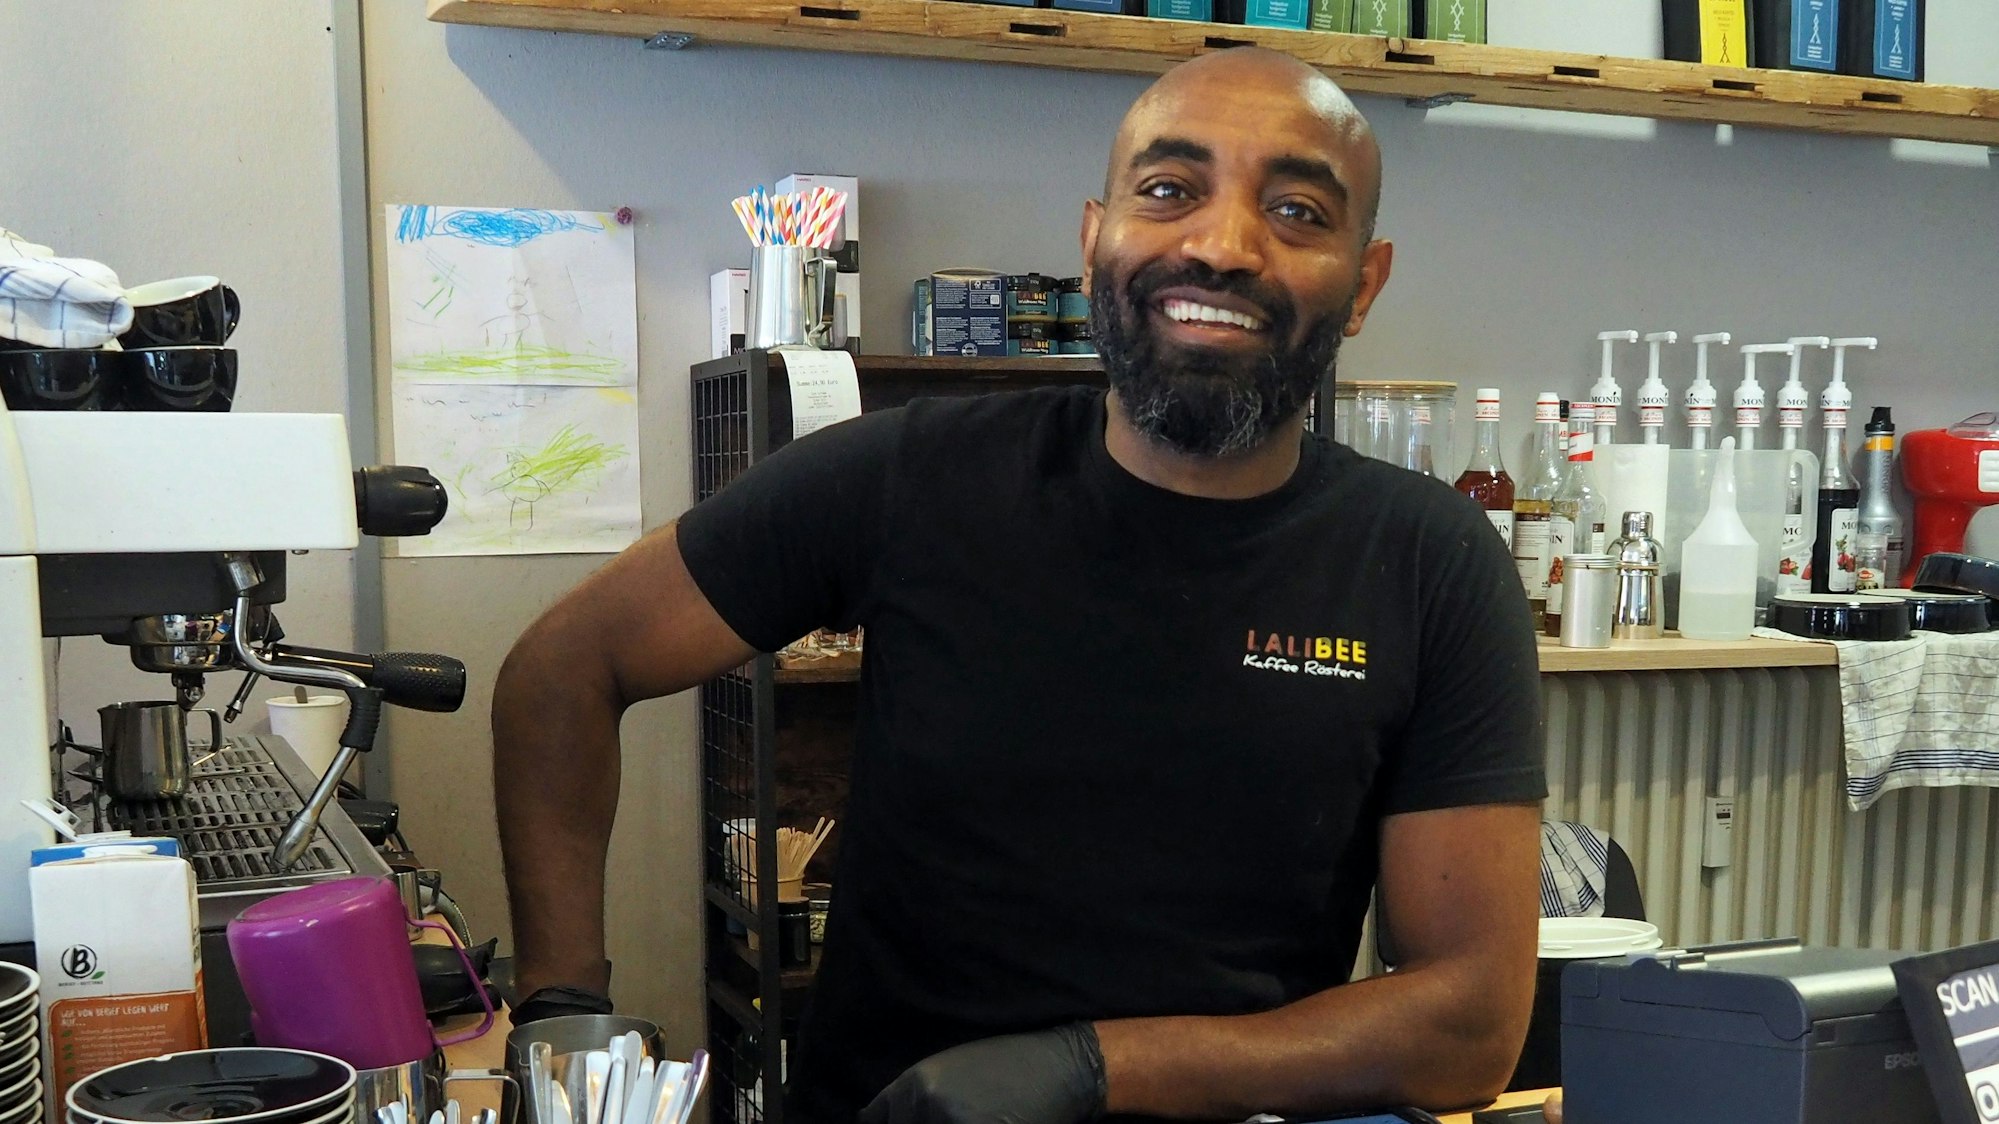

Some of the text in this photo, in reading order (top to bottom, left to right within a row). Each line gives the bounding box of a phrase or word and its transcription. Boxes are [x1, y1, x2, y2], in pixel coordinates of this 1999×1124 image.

[1247, 629, 1367, 665] LALIBEE
[1243, 653, 1366, 680] Kaffee Rösterei
[1936, 972, 1999, 1017] SCAN
